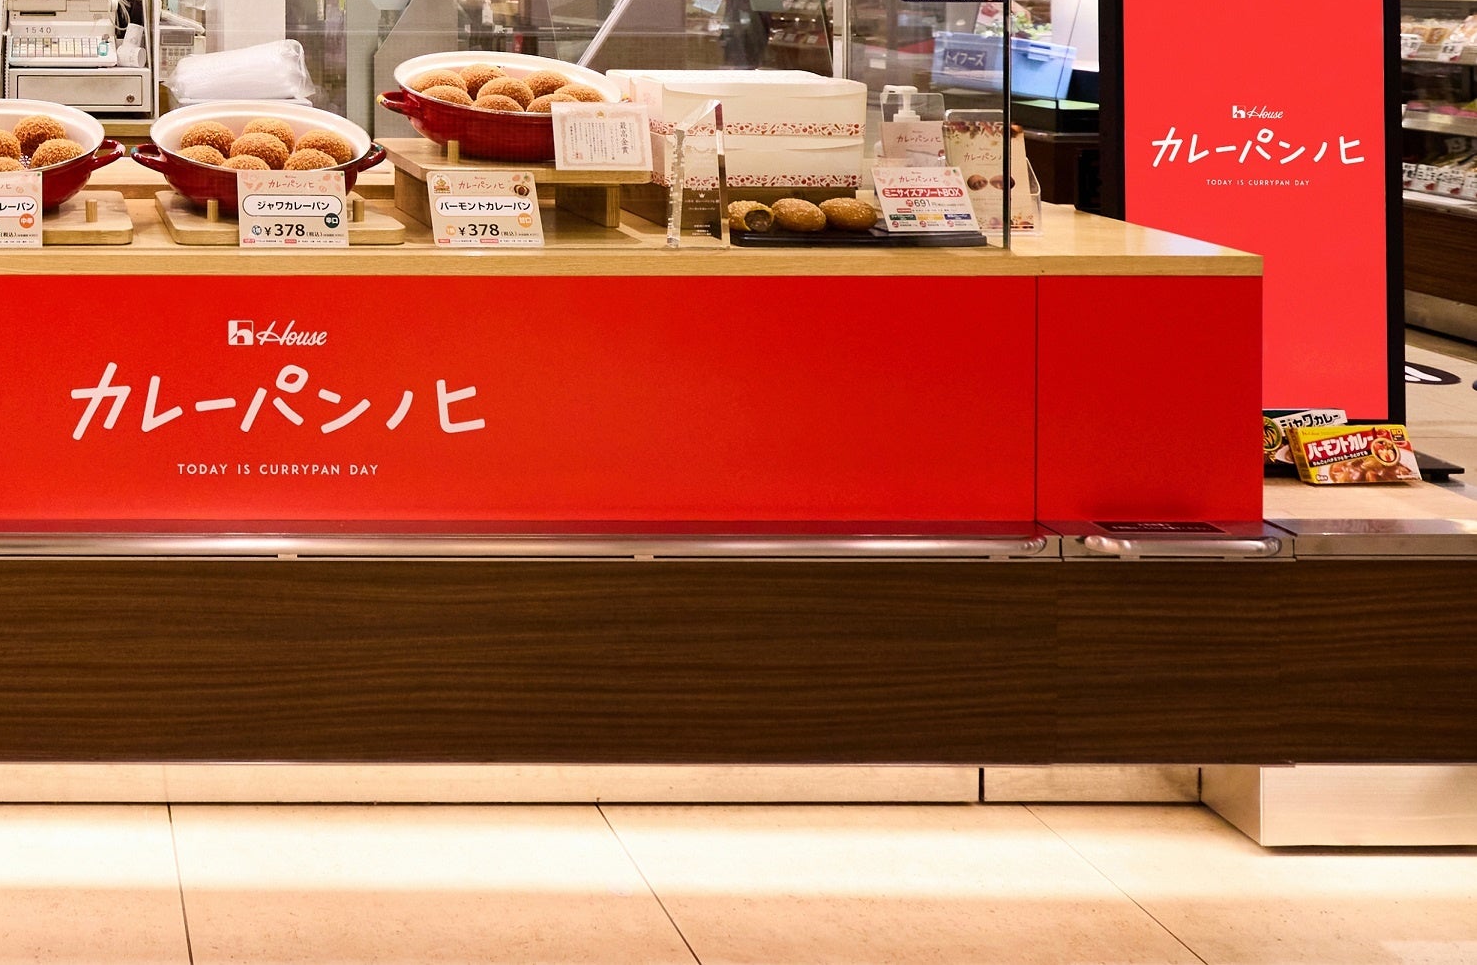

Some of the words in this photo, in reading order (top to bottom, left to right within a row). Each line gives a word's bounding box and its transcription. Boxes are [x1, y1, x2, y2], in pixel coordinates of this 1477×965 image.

[1151, 126, 1365, 168] カレーパンノヒ
[269, 180, 314, 188] カレーパンノヒ
[459, 181, 504, 189] カレーパンノヒ
[884, 188, 962, 197] ミニサイズアソートBOX
[258, 202, 329, 210] ジャワカレーパン
[440, 202, 530, 211] バーモントカレーパン
[265, 224, 305, 236] ¥378
[459, 224, 499, 236] ¥378
[256, 320, 328, 346] House
[70, 362, 486, 441] カレーパンノヒ
[1280, 414, 1340, 428] ジャワカレー
[1308, 434, 1373, 460] バーモントカレー
[177, 463, 228, 476] TODAY
[237, 464, 251, 475] IS
[259, 464, 340, 476] CURRYPAN
[350, 464, 379, 476] DAY
